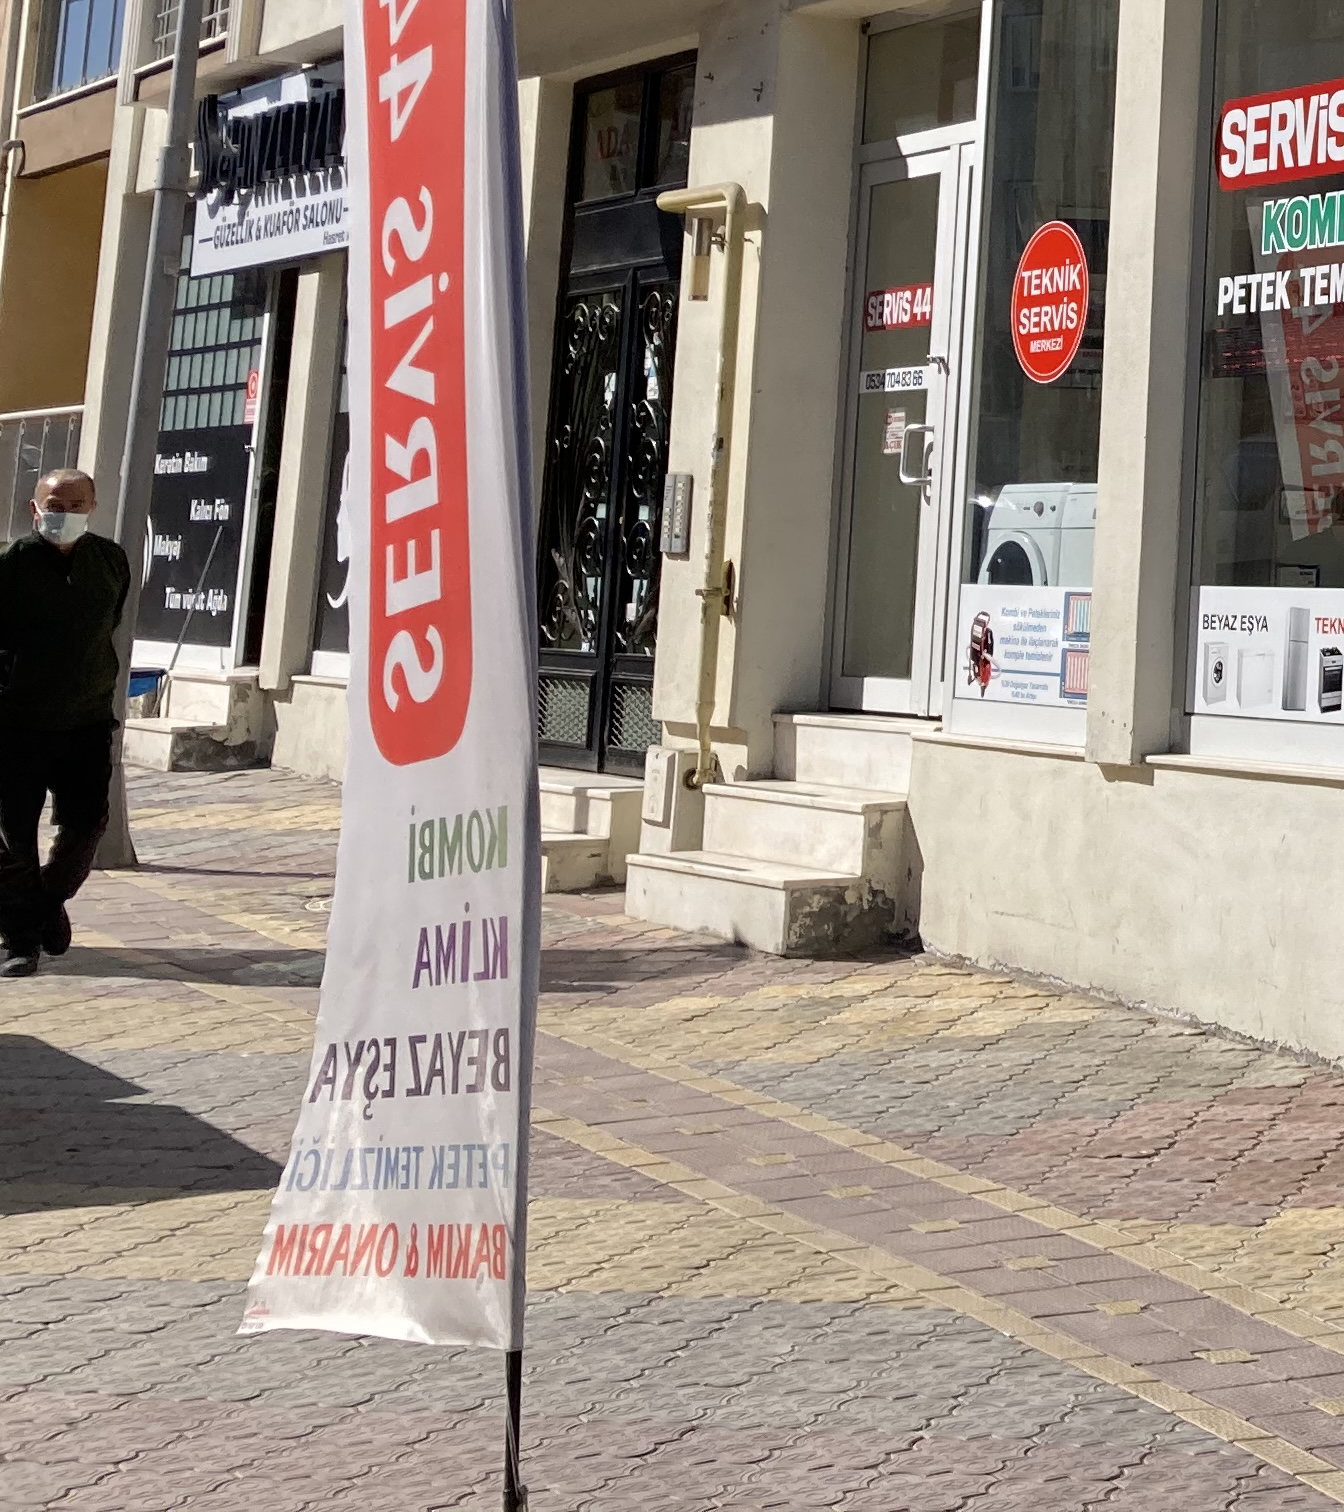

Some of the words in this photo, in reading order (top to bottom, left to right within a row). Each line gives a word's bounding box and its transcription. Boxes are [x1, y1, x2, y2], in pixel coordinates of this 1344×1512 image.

[263, 199, 299, 238] KUAFÖR
[302, 197, 344, 231] SALONU
[1020, 258, 1082, 297] TEKNİK
[1217, 269, 1292, 316] PETEK
[912, 287, 932, 321] 44
[1018, 297, 1078, 336] SERVİS
[1202, 613, 1238, 631] BEYAZ
[1240, 615, 1269, 636] EŞYA
